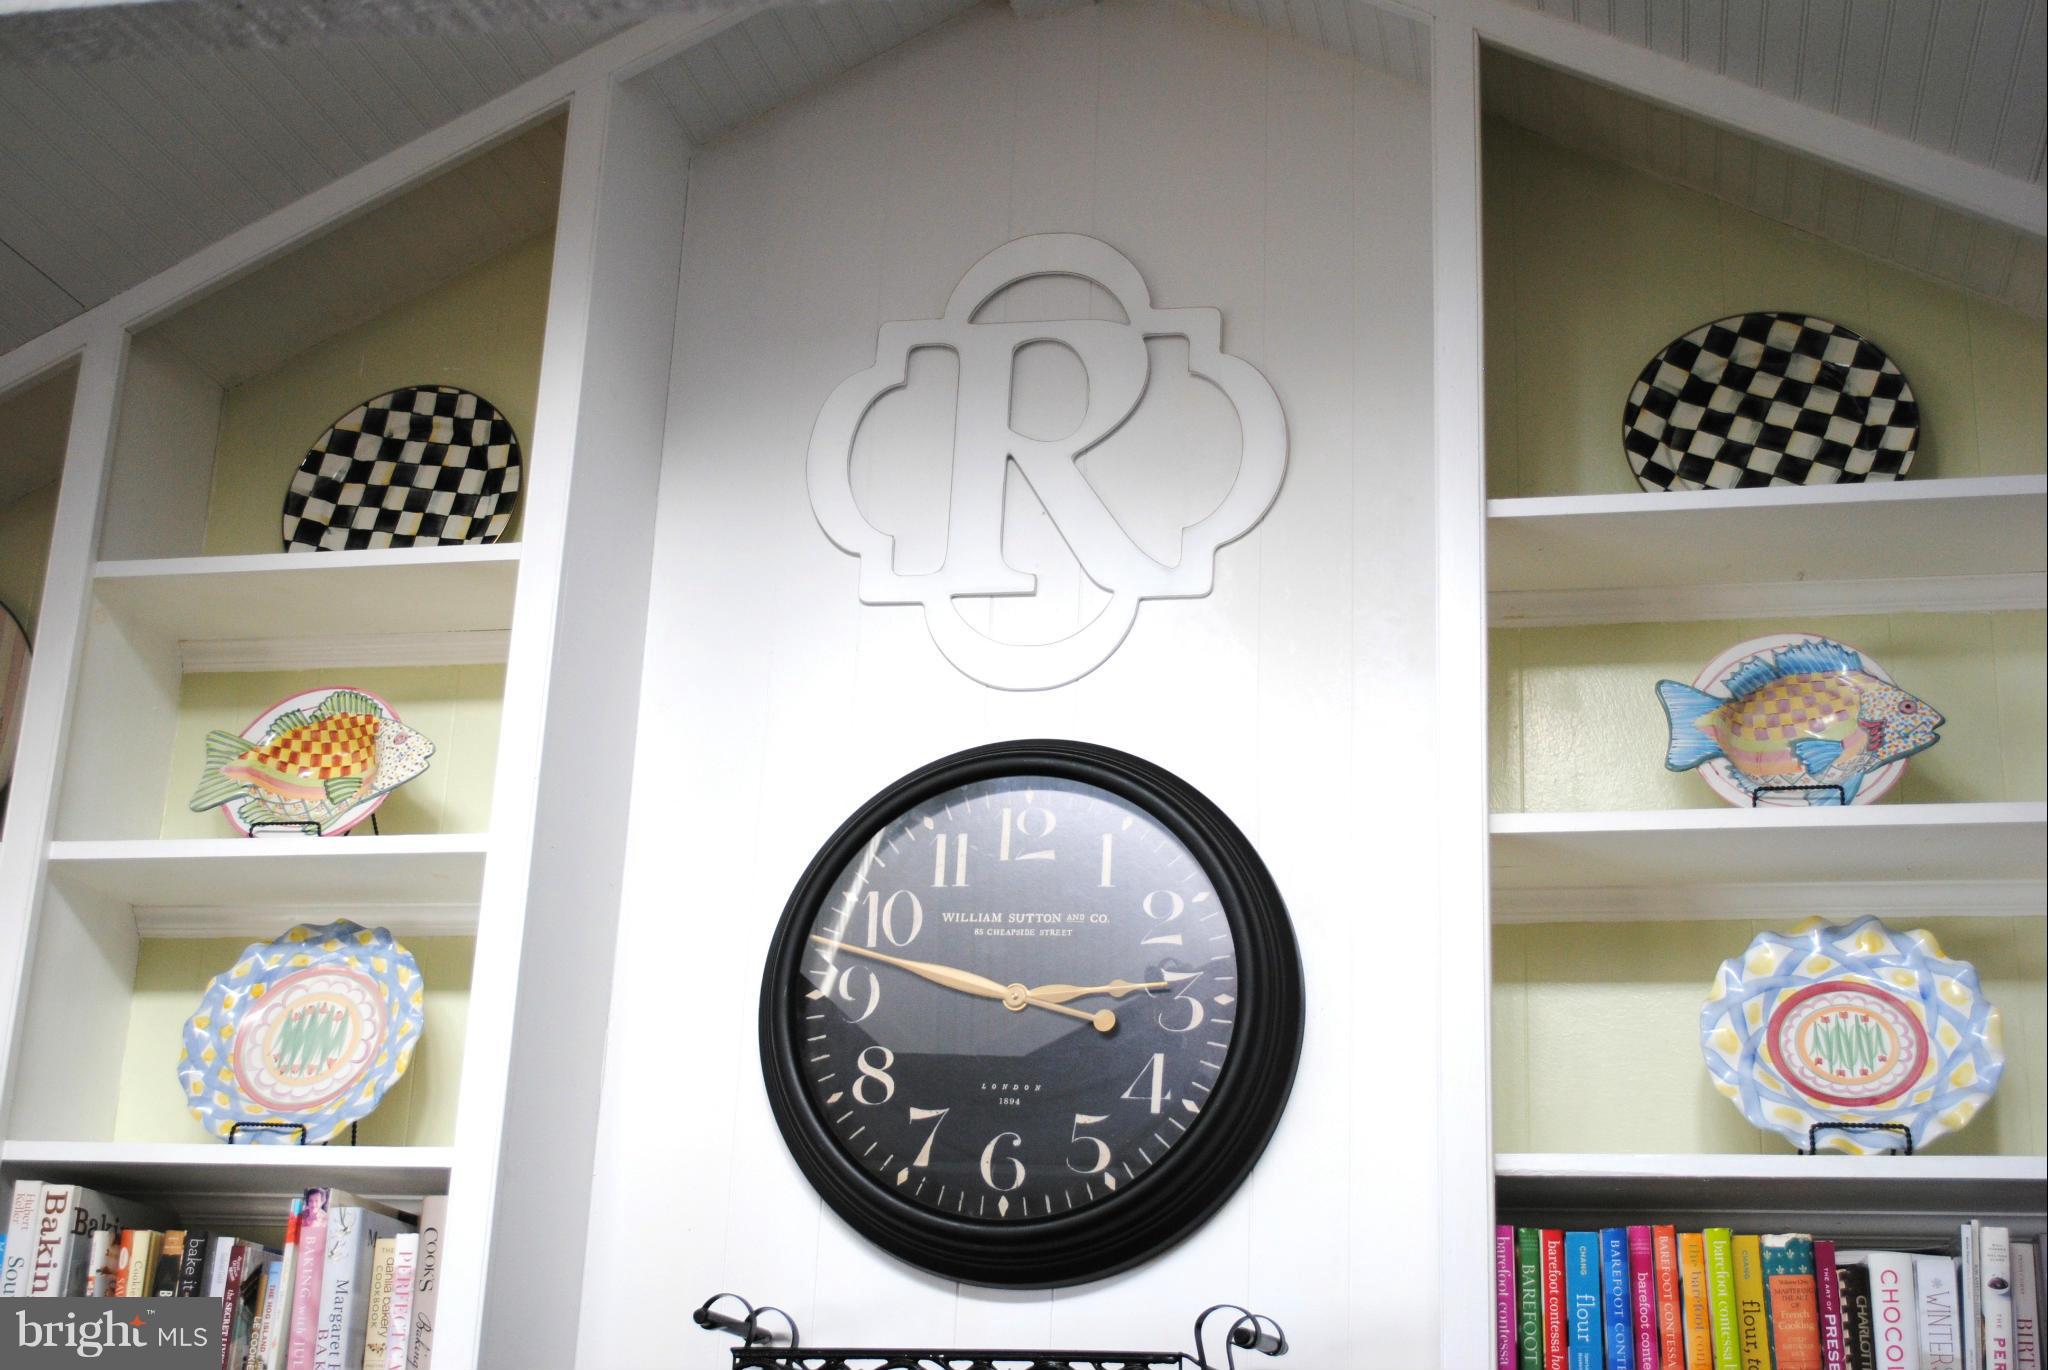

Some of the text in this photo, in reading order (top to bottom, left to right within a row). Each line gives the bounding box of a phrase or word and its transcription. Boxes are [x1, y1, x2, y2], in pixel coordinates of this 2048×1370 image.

[931, 833, 968, 888] 11
[999, 807, 1057, 862] 12
[1097, 833, 1115, 888] 1
[862, 889, 923, 948] 10
[942, 912, 1111, 924] WILLIAM SUTTON AND CO.
[986, 928, 1035, 936] CHEAPSIDE
[1039, 928, 1073, 936] STREET
[1141, 890, 1185, 945] 2
[838, 965, 881, 1024] 9
[1158, 968, 1204, 1032] 3
[851, 1045, 895, 1105] 8
[981, 1083, 1042, 1091] LONDON
[999, 1097, 1020, 1105] 1894
[1121, 1053, 1172, 1114] 4
[909, 1107, 950, 1167] 7
[979, 1131, 1026, 1191] 6
[1067, 1114, 1112, 1174] 5
[32, 1191, 68, 1295] Bakin
[182, 1238, 205, 1292] bake it
[300, 1236, 317, 1297] BAKING
[1547, 1240, 1561, 1295] barefoot
[1579, 1246, 1588, 1276] CHANG
[1712, 1240, 1730, 1297] barefoot
[1497, 1236, 1511, 1365] barefoot contessa
[1610, 1240, 1625, 1318] BAREFOOT
[1637, 1272, 1651, 1329] barefoot
[1658, 1236, 1677, 1369] BAREFOOT CONTESSA
[328, 1280, 350, 1356] Margaret
[407, 1311, 431, 1369] Baking
[1522, 1264, 1538, 1365] BAREFOOT
[1550, 1298, 1561, 1353] contessa
[1576, 1294, 1596, 1343] flour
[1718, 1301, 1734, 1361] contessa
[1926, 1291, 1954, 1370] WINTER
